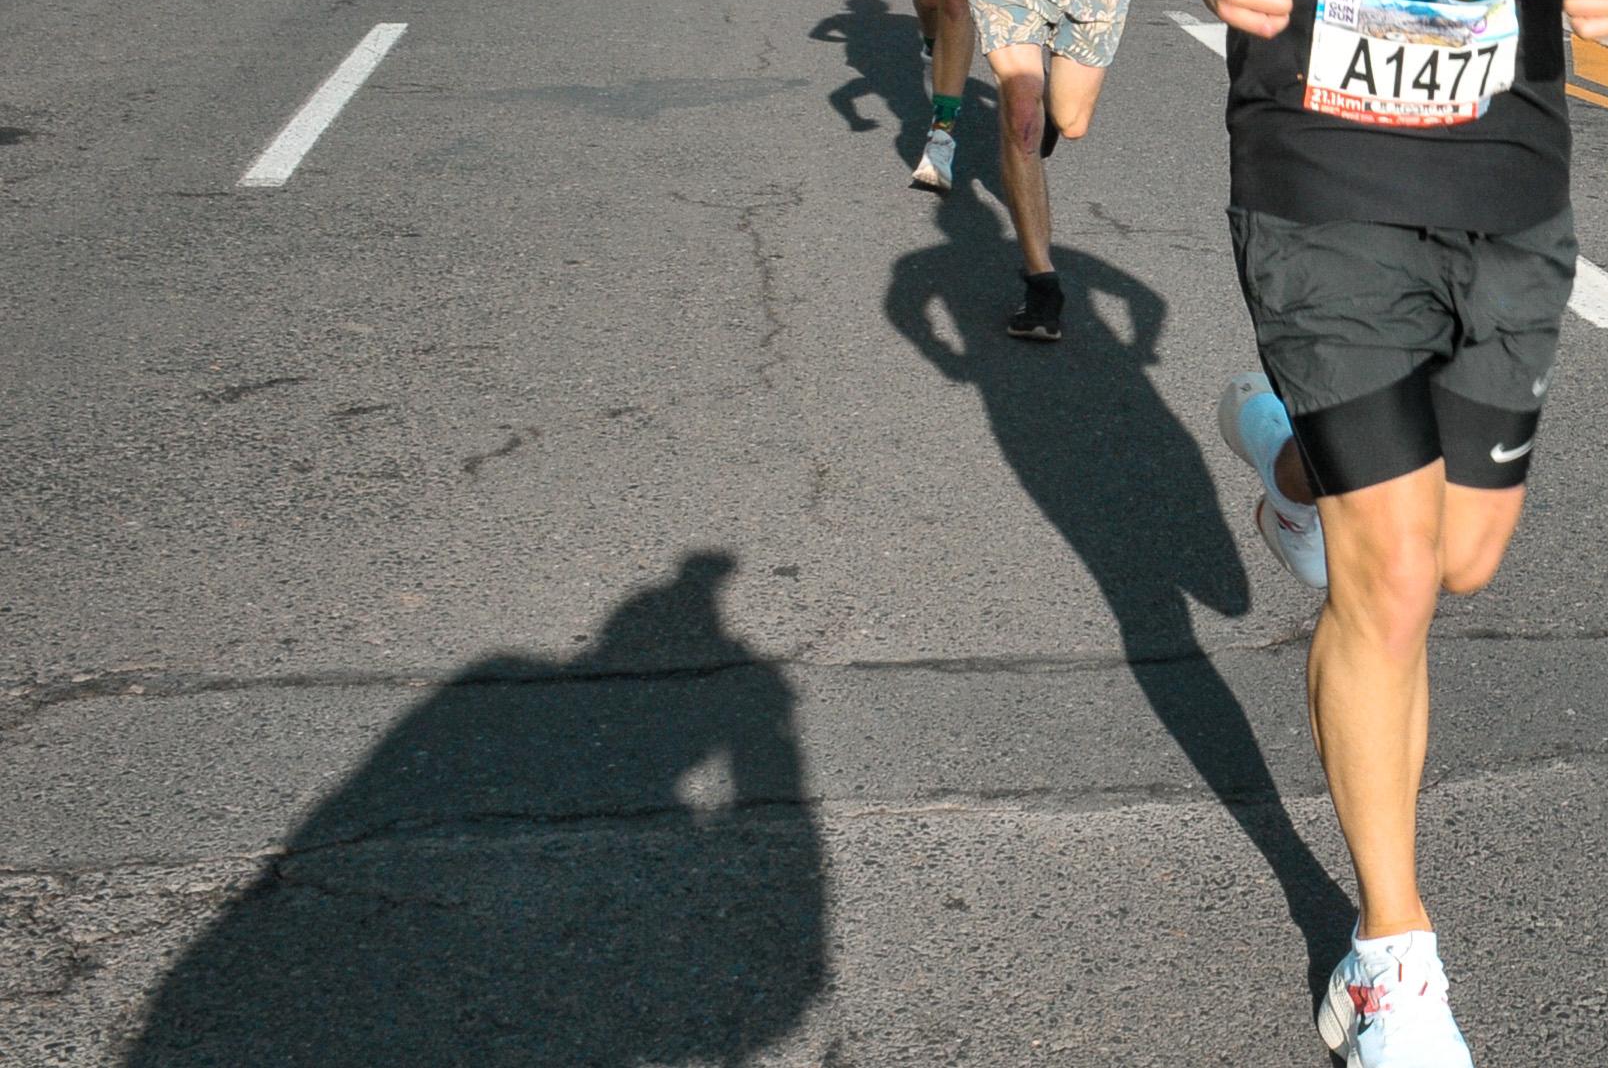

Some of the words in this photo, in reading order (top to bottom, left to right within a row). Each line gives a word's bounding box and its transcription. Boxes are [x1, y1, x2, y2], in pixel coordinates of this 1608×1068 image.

[1329, 1, 1355, 15] GUN
[1328, 10, 1354, 24] RUN
[1340, 37, 1499, 101] A1477
